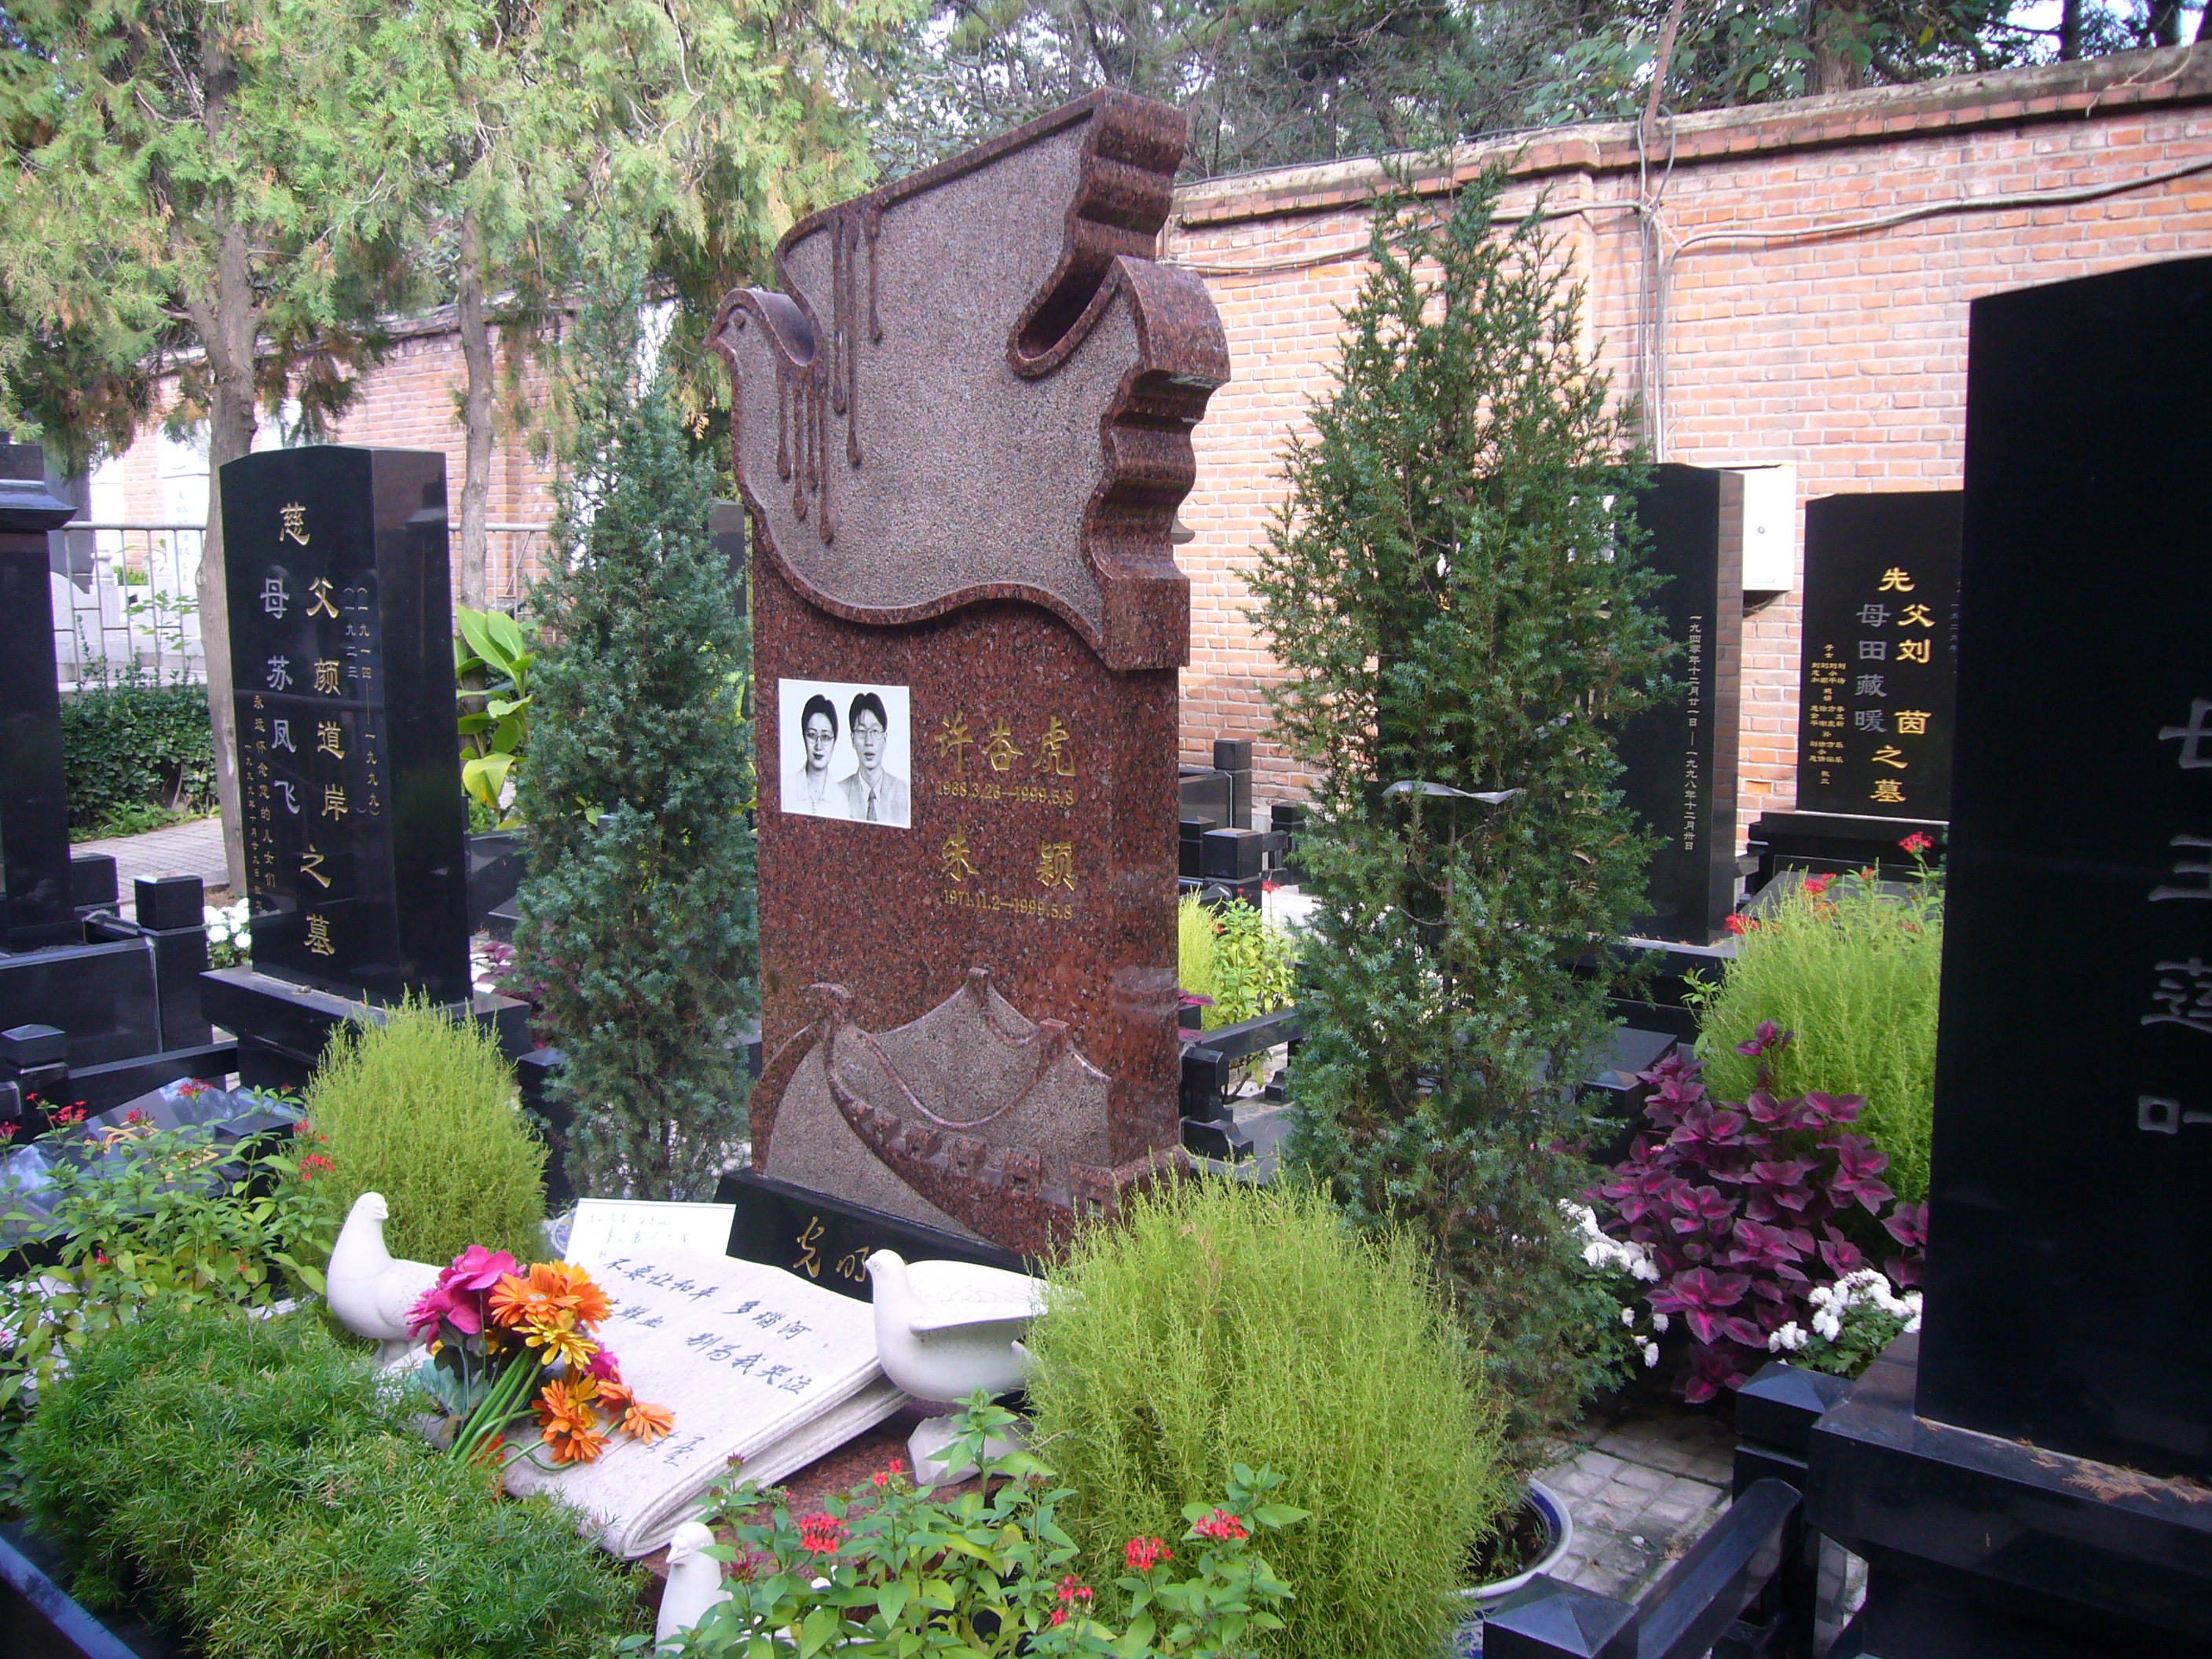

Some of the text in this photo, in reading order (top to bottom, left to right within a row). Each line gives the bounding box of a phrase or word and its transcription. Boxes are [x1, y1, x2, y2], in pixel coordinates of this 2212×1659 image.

[280, 501, 310, 546] 慈
[1878, 566, 1916, 592] 先
[260, 577, 300, 815] 母苏凤飞
[306, 577, 348, 822] 父颜道岸
[1894, 602, 1936, 735] 父刘茵
[934, 709, 1076, 777] 许杏虎
[1870, 744, 1909, 803] 之墓
[942, 825, 1075, 891] 朱颖
[299, 843, 335, 957] 之墓
[793, 1215, 908, 1283] 光明
[613, 1297, 665, 1329] 鲜血
